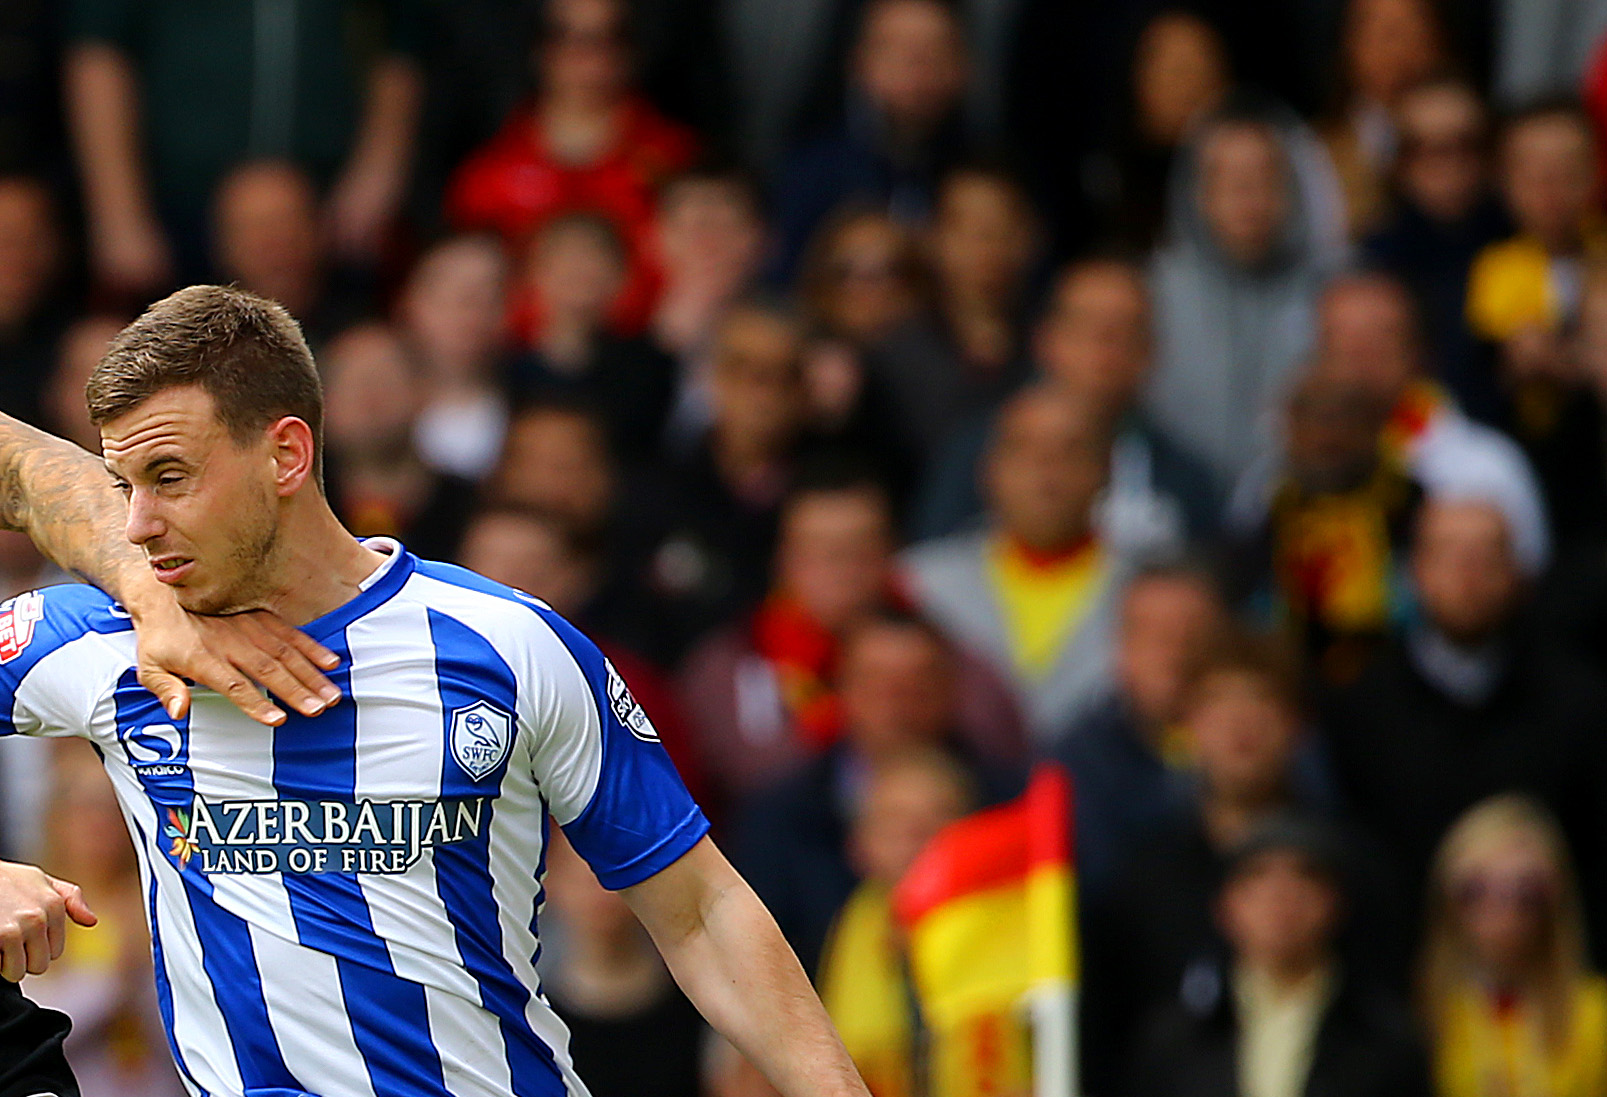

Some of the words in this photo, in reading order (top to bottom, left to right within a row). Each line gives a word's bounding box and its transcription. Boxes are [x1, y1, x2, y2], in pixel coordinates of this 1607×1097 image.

[462, 746, 498, 762] SWFC
[187, 794, 484, 865] AZERBAIJAN
[202, 849, 277, 872] LAND
[288, 848, 327, 872] OF
[343, 849, 407, 872] FIRE
